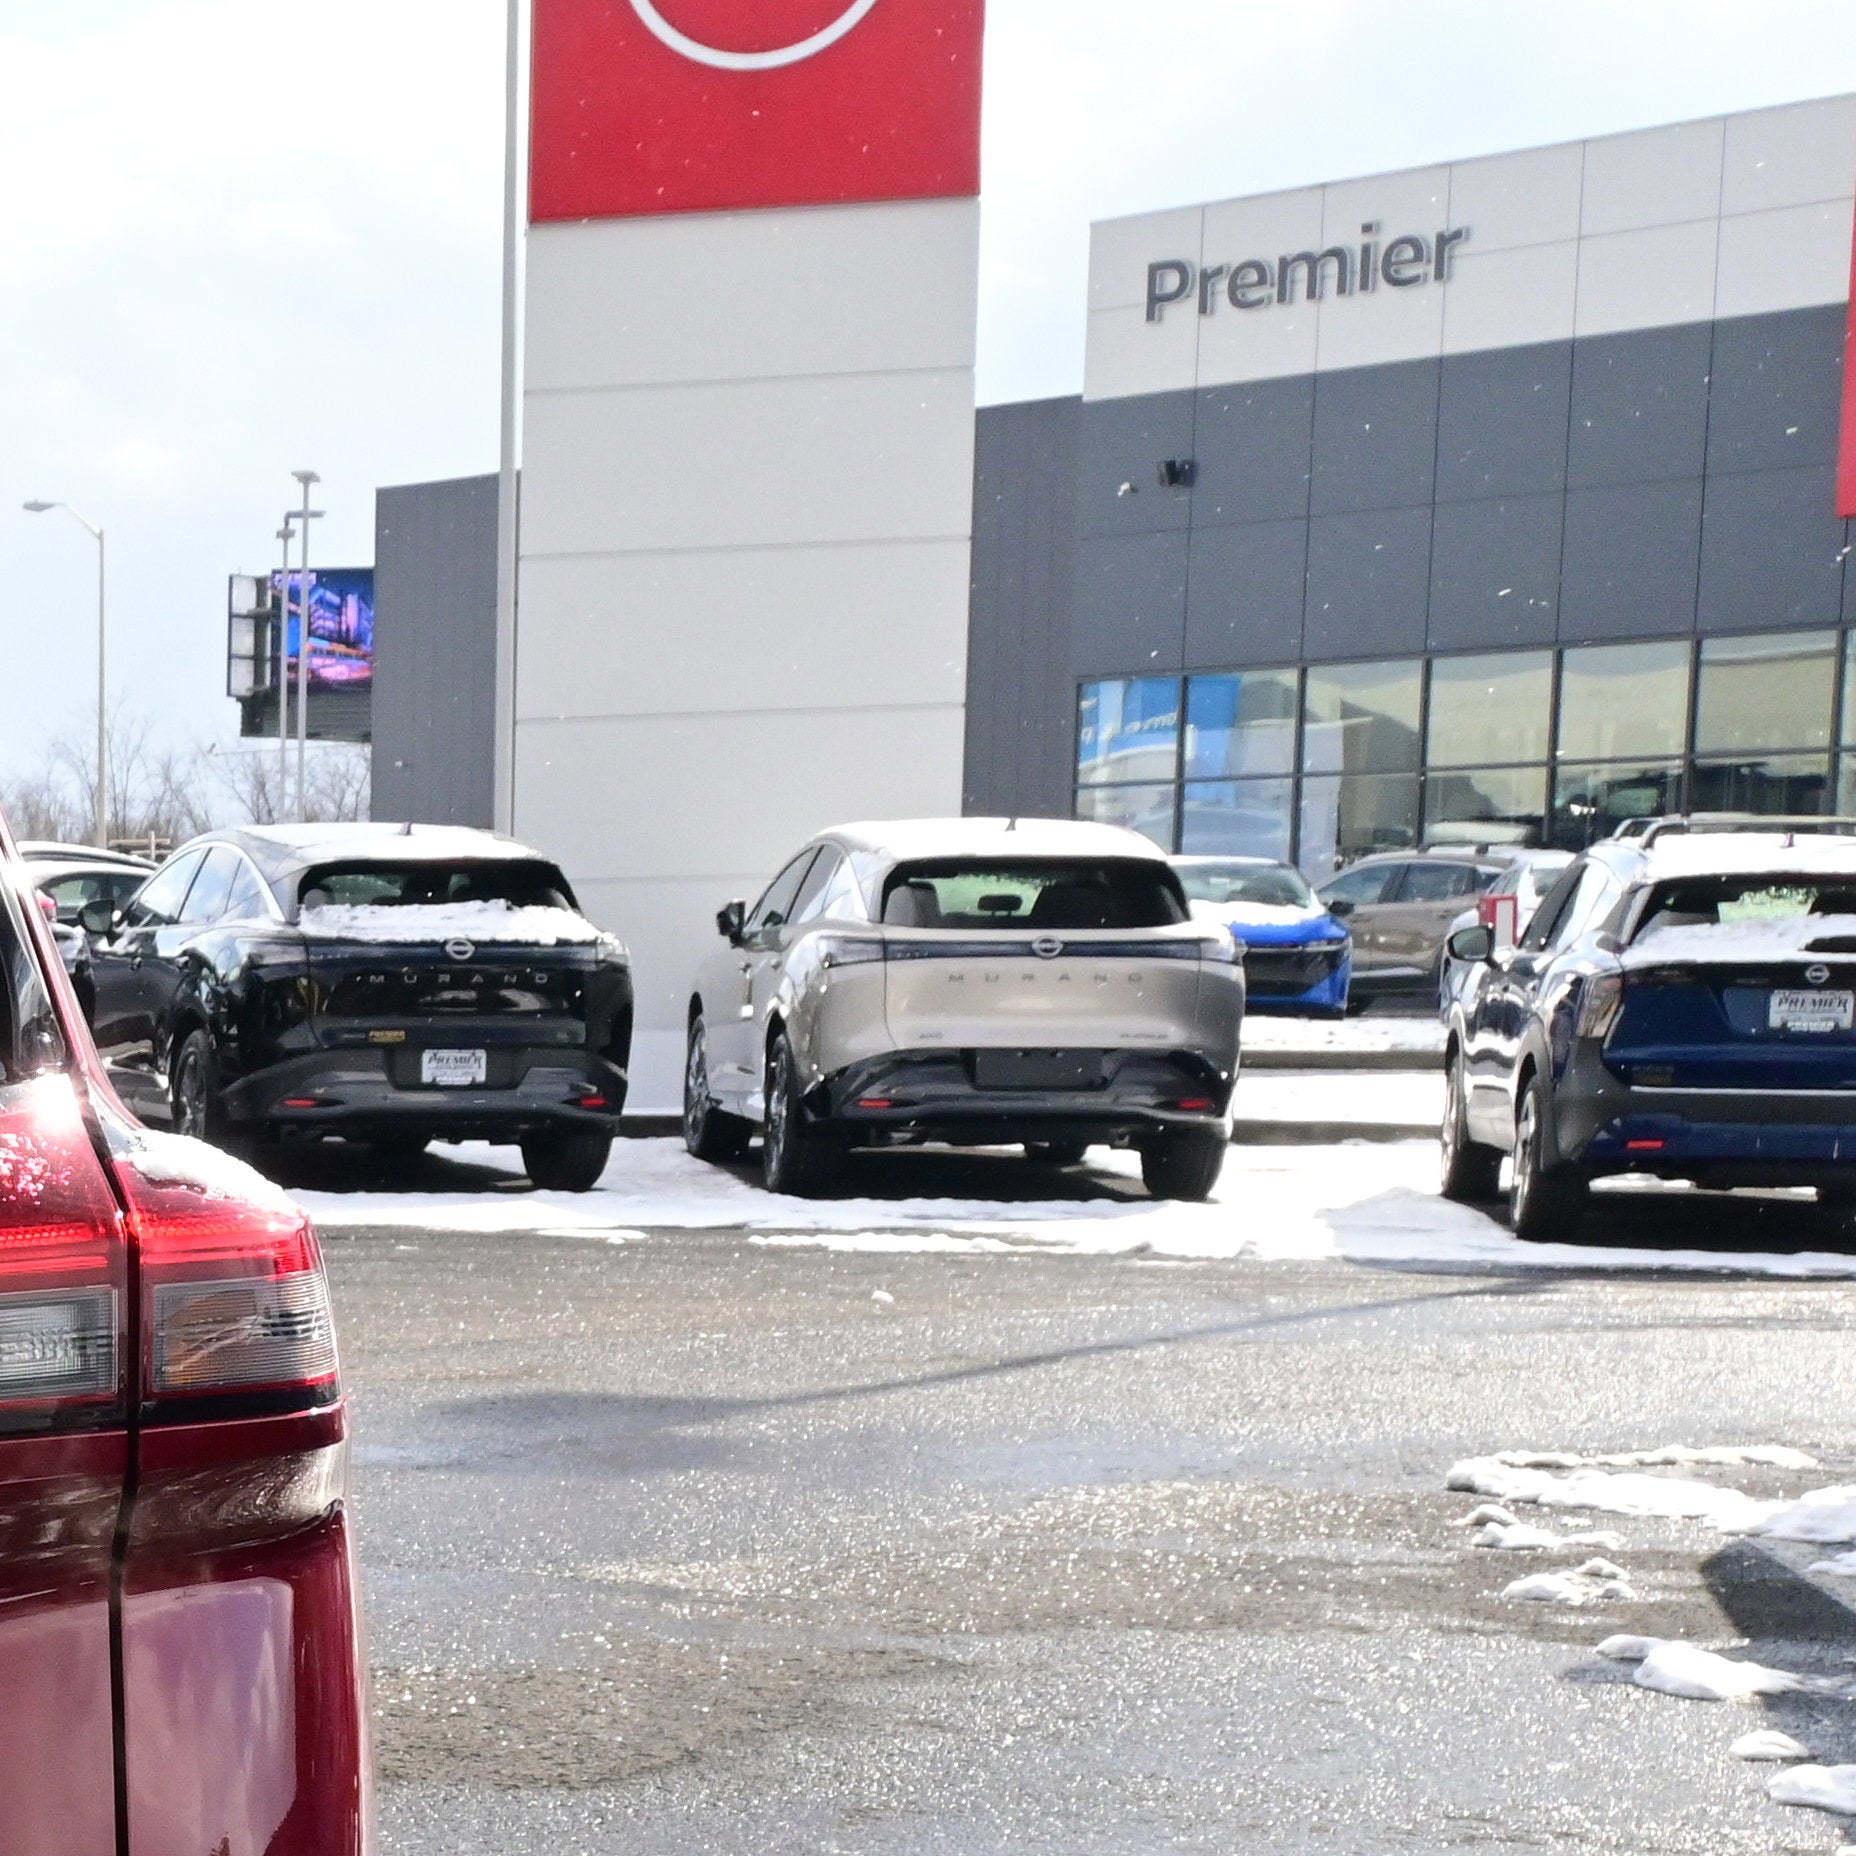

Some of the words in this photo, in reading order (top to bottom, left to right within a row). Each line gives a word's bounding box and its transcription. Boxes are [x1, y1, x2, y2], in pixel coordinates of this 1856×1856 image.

[1144, 219, 1470, 324] Premier
[369, 973, 549, 985] MURANO
[948, 972, 1143, 983] MURANO
